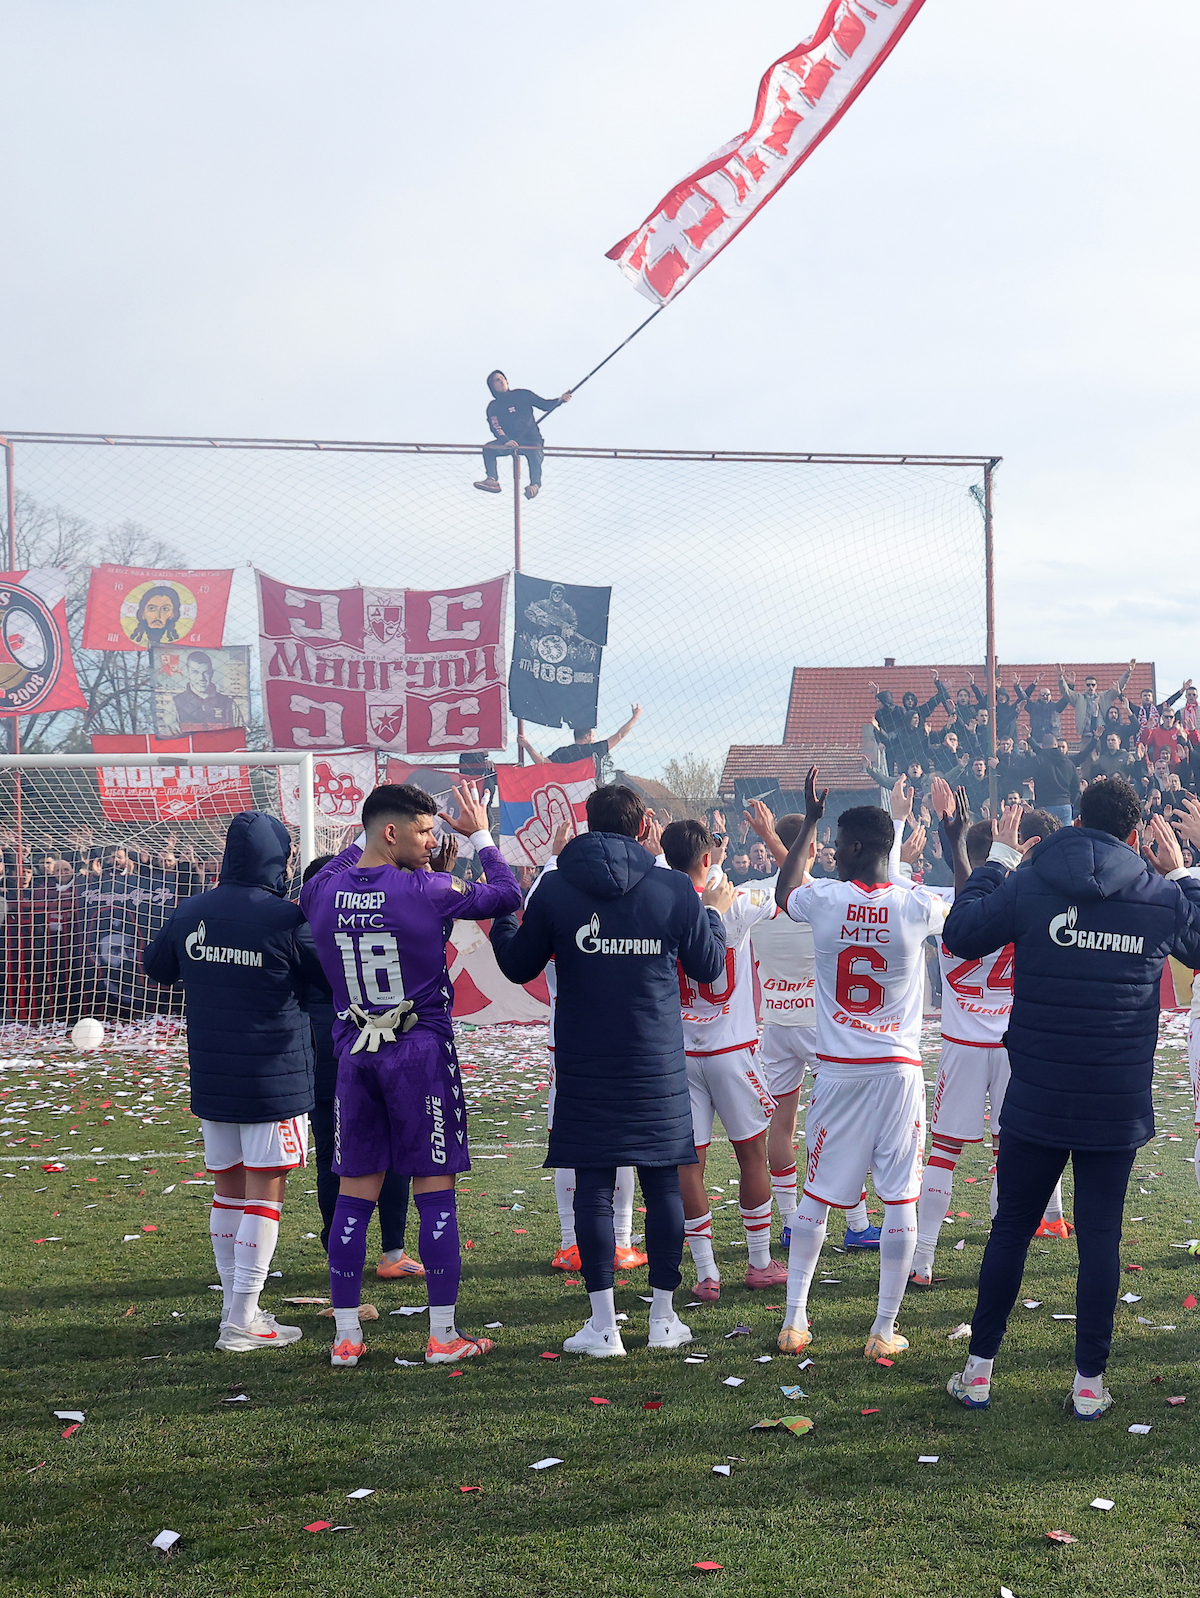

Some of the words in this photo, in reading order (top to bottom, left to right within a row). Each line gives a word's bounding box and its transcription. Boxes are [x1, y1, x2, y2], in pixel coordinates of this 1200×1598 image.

[8, 674, 45, 705] 2008
[334, 891, 386, 909] ГЛАЗЕР
[601, 938, 661, 955] GAZPROM
[1077, 932, 1145, 955] GAZPROM
[205, 945, 263, 968] GAZPROM
[333, 932, 405, 1006] 18
[836, 945, 888, 1017] 6
